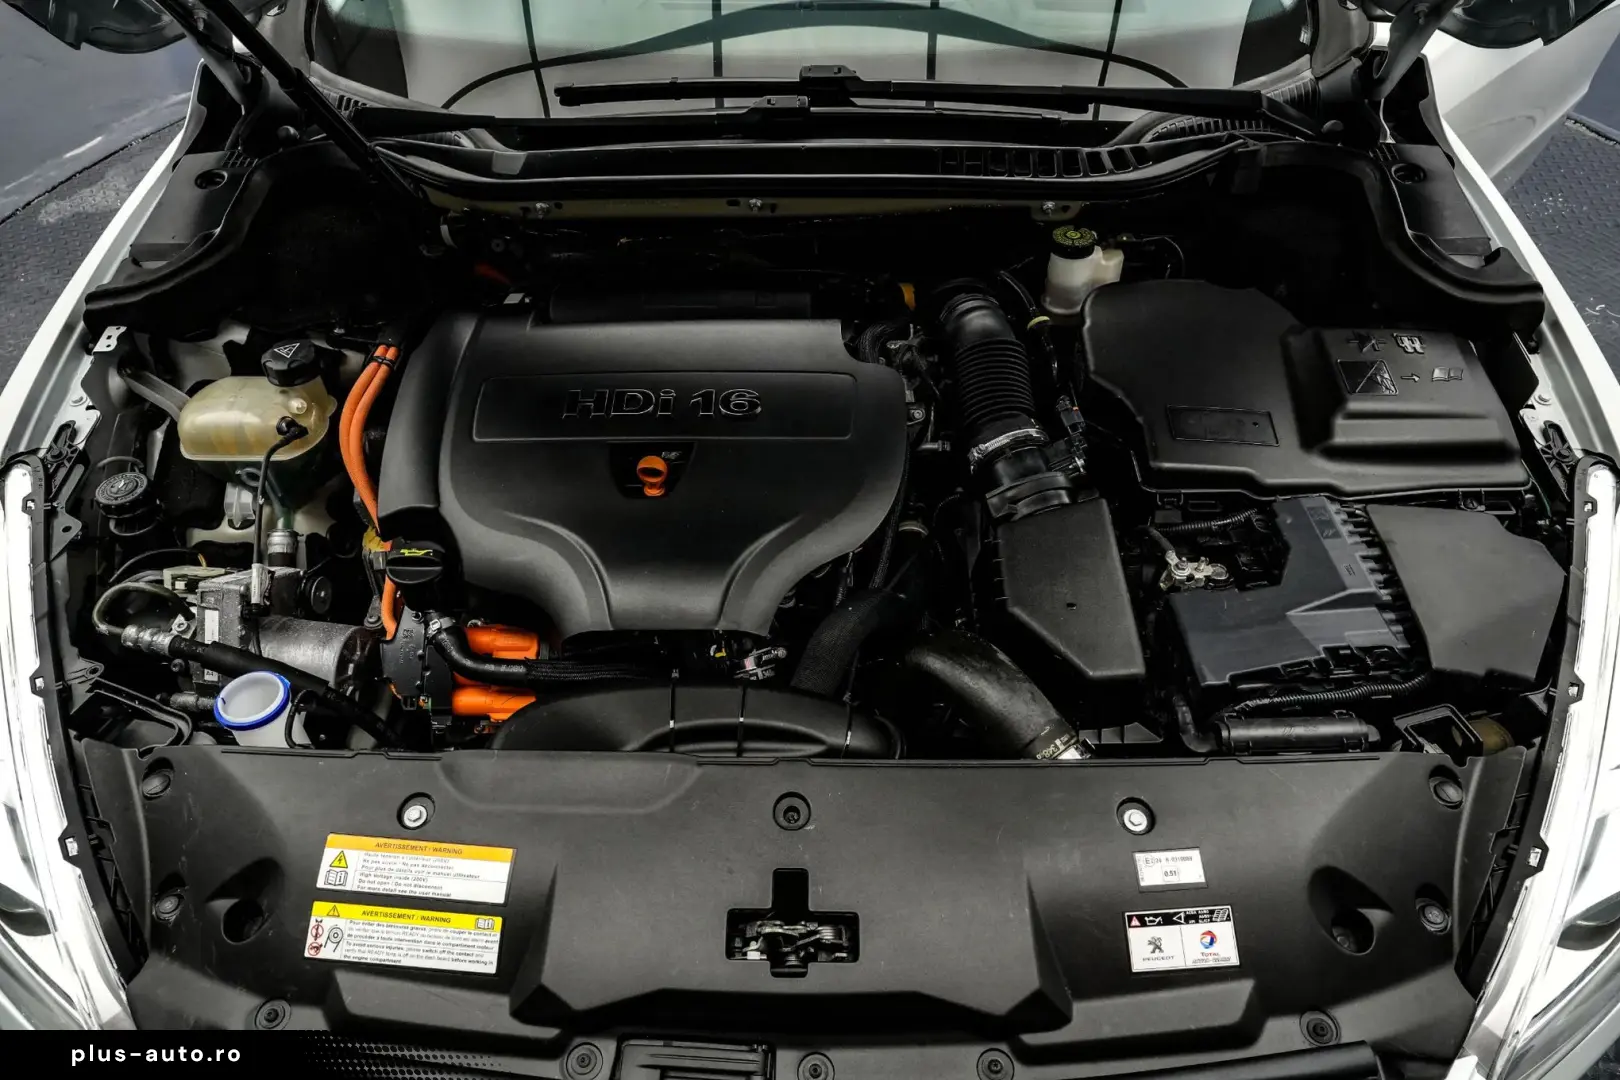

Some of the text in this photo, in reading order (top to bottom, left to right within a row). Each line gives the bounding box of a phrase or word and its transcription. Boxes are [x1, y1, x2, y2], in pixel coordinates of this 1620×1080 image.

[562, 389, 762, 418] HDi 16
[375, 842, 428, 852] AVERTISSEMENT
[432, 846, 463, 855] WARNING
[361, 910, 416, 920] AVERTISSEMENT
[420, 915, 451, 923] WARNING
